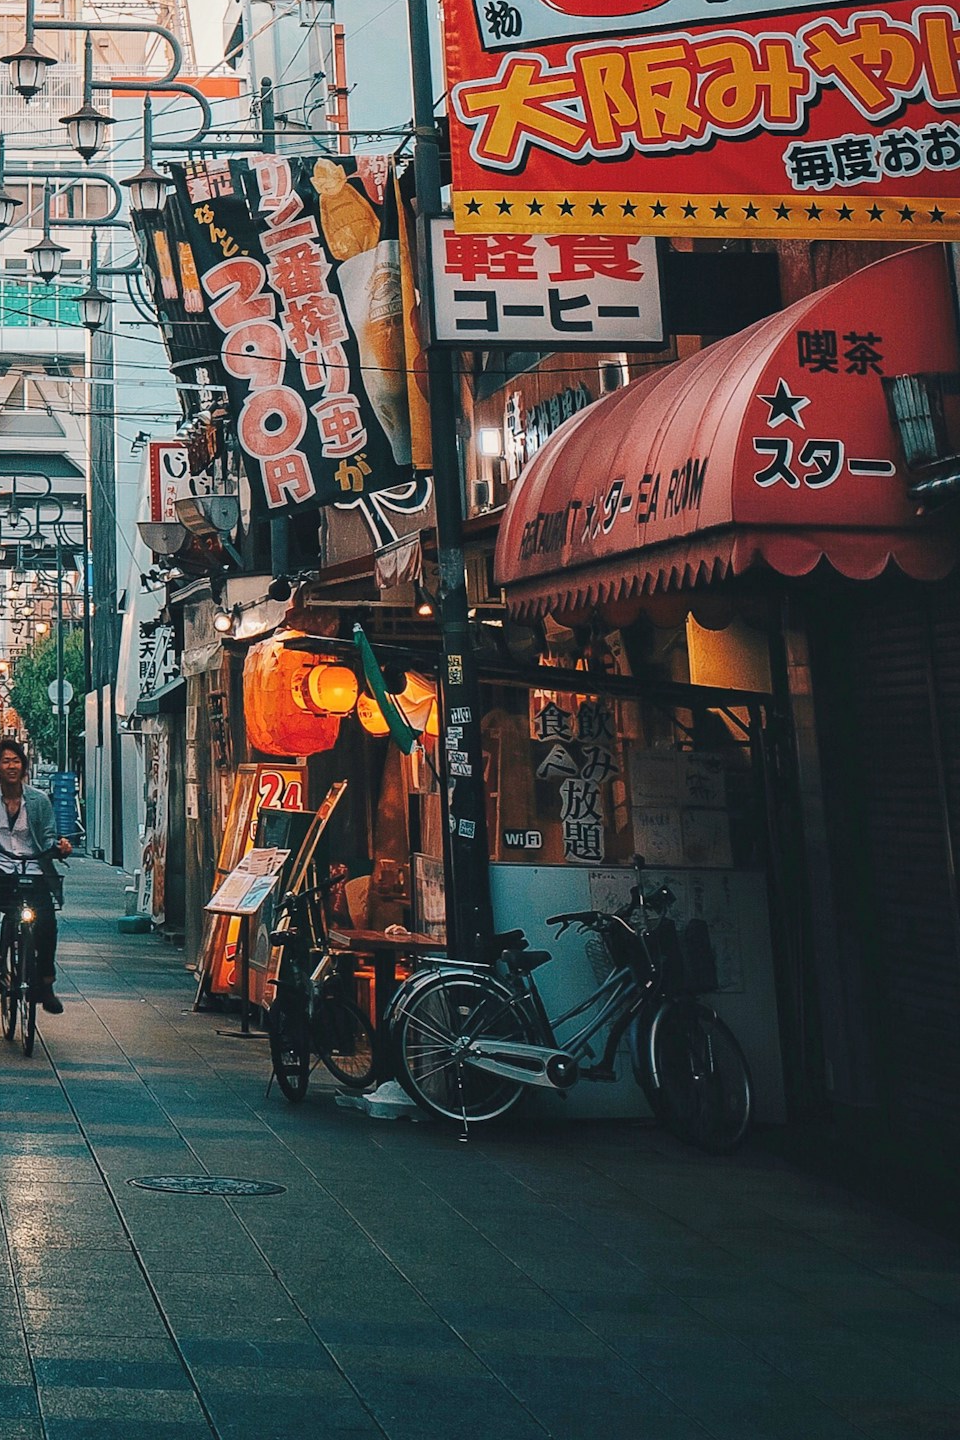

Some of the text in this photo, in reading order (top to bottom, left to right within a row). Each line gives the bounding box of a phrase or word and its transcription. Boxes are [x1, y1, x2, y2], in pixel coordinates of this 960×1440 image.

[444, 235, 645, 282] 軽食
[454, 288, 640, 333] コーヒー
[797, 329, 885, 376] 喫茶
[202, 256, 313, 509] 290円
[753, 437, 896, 489] スター
[576, 701, 620, 782] 飲み
[258, 771, 303, 810] 24
[561, 779, 604, 863] 放題
